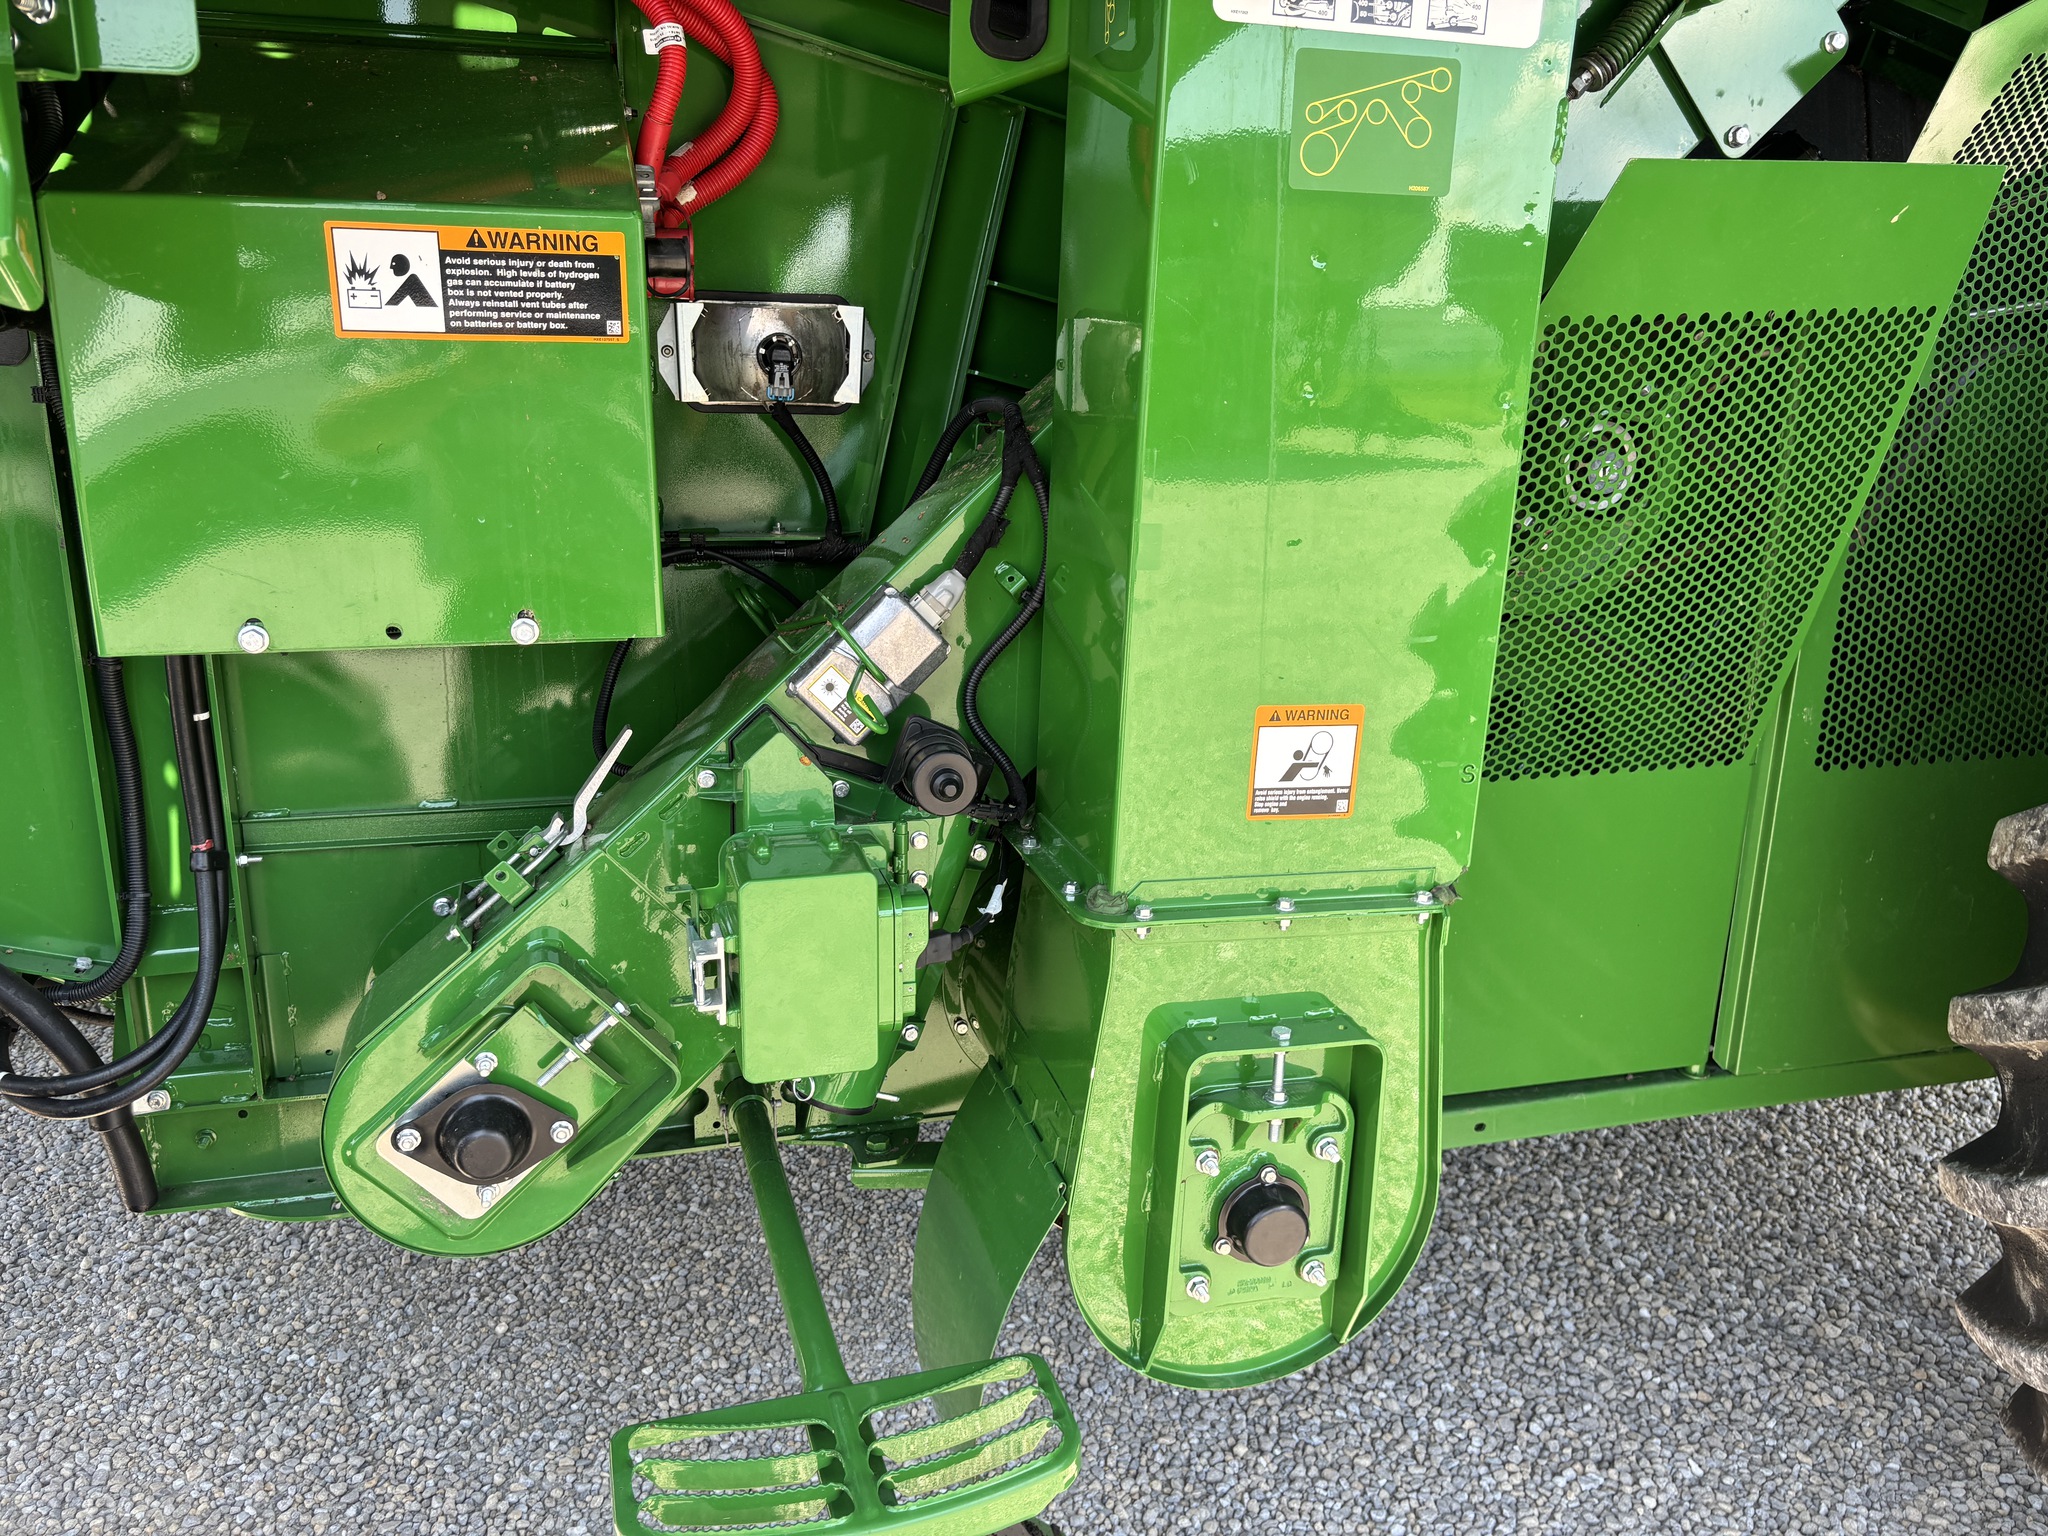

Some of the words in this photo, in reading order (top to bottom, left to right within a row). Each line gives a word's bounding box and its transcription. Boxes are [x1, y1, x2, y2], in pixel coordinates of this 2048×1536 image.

[487, 231, 598, 252] WARNING
[445, 256, 471, 265] Avoid
[473, 258, 506, 266] serious
[508, 259, 534, 268] injury
[548, 260, 572, 268] death
[445, 268, 492, 276] explosion.
[497, 268, 518, 278] High
[547, 270, 556, 278] of
[558, 271, 600, 281] hydrogen
[446, 279, 463, 287] gas
[484, 279, 534, 288] accumulate
[536, 280, 543, 288] if
[545, 281, 576, 290] battery
[447, 288, 464, 296] box
[466, 288, 475, 296] is
[477, 289, 492, 297] not
[494, 290, 524, 298] vented
[526, 291, 564, 300] properly.
[448, 299, 480, 308] Always
[482, 300, 518, 308] reinstall
[541, 301, 566, 309] tubes
[449, 309, 498, 319] performing
[546, 312, 601, 320] maintenance
[464, 320, 503, 328] batteries
[517, 320, 547, 330] battery
[1285, 709, 1350, 721] WARNING
[1461, 764, 1476, 784] S
